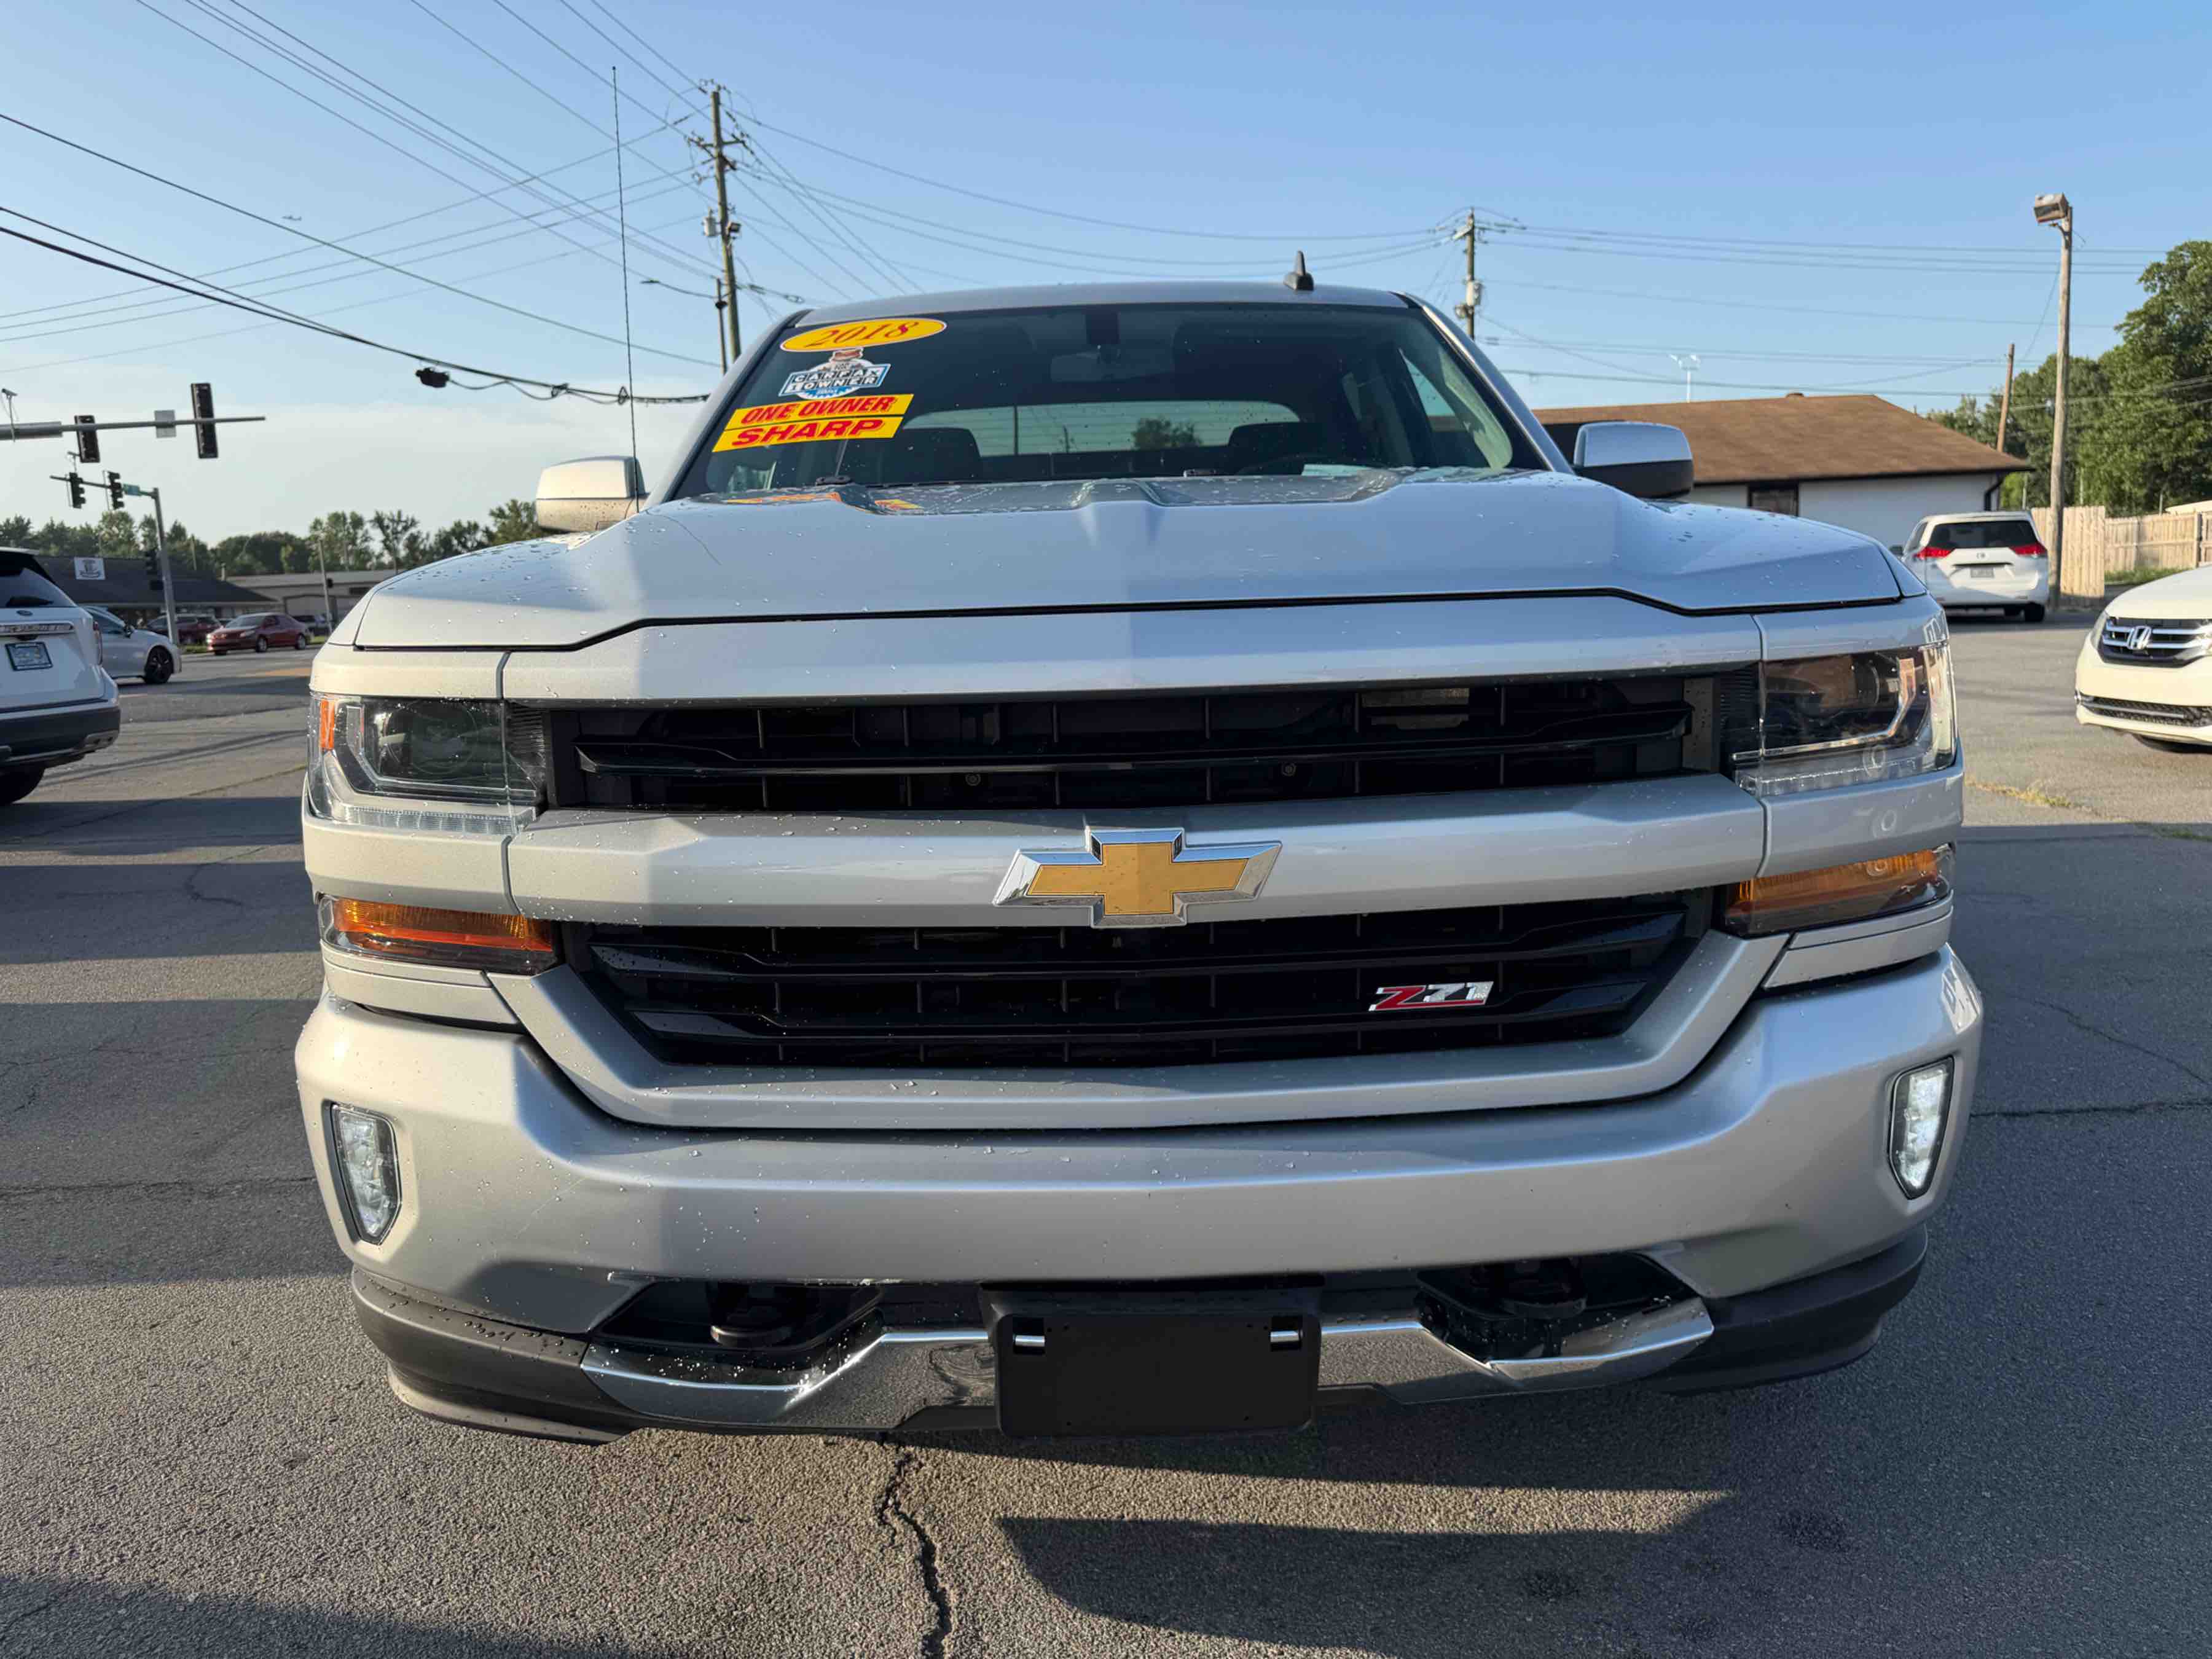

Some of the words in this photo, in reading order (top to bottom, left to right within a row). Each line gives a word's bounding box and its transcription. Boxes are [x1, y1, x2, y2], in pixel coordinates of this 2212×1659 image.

[805, 321, 919, 348] 2018
[794, 367, 881, 383] CARFAX
[741, 403, 799, 425] ONE
[798, 396, 898, 418] OWNER
[732, 419, 885, 446] SHARP
[1368, 981, 1494, 1011] Z71
